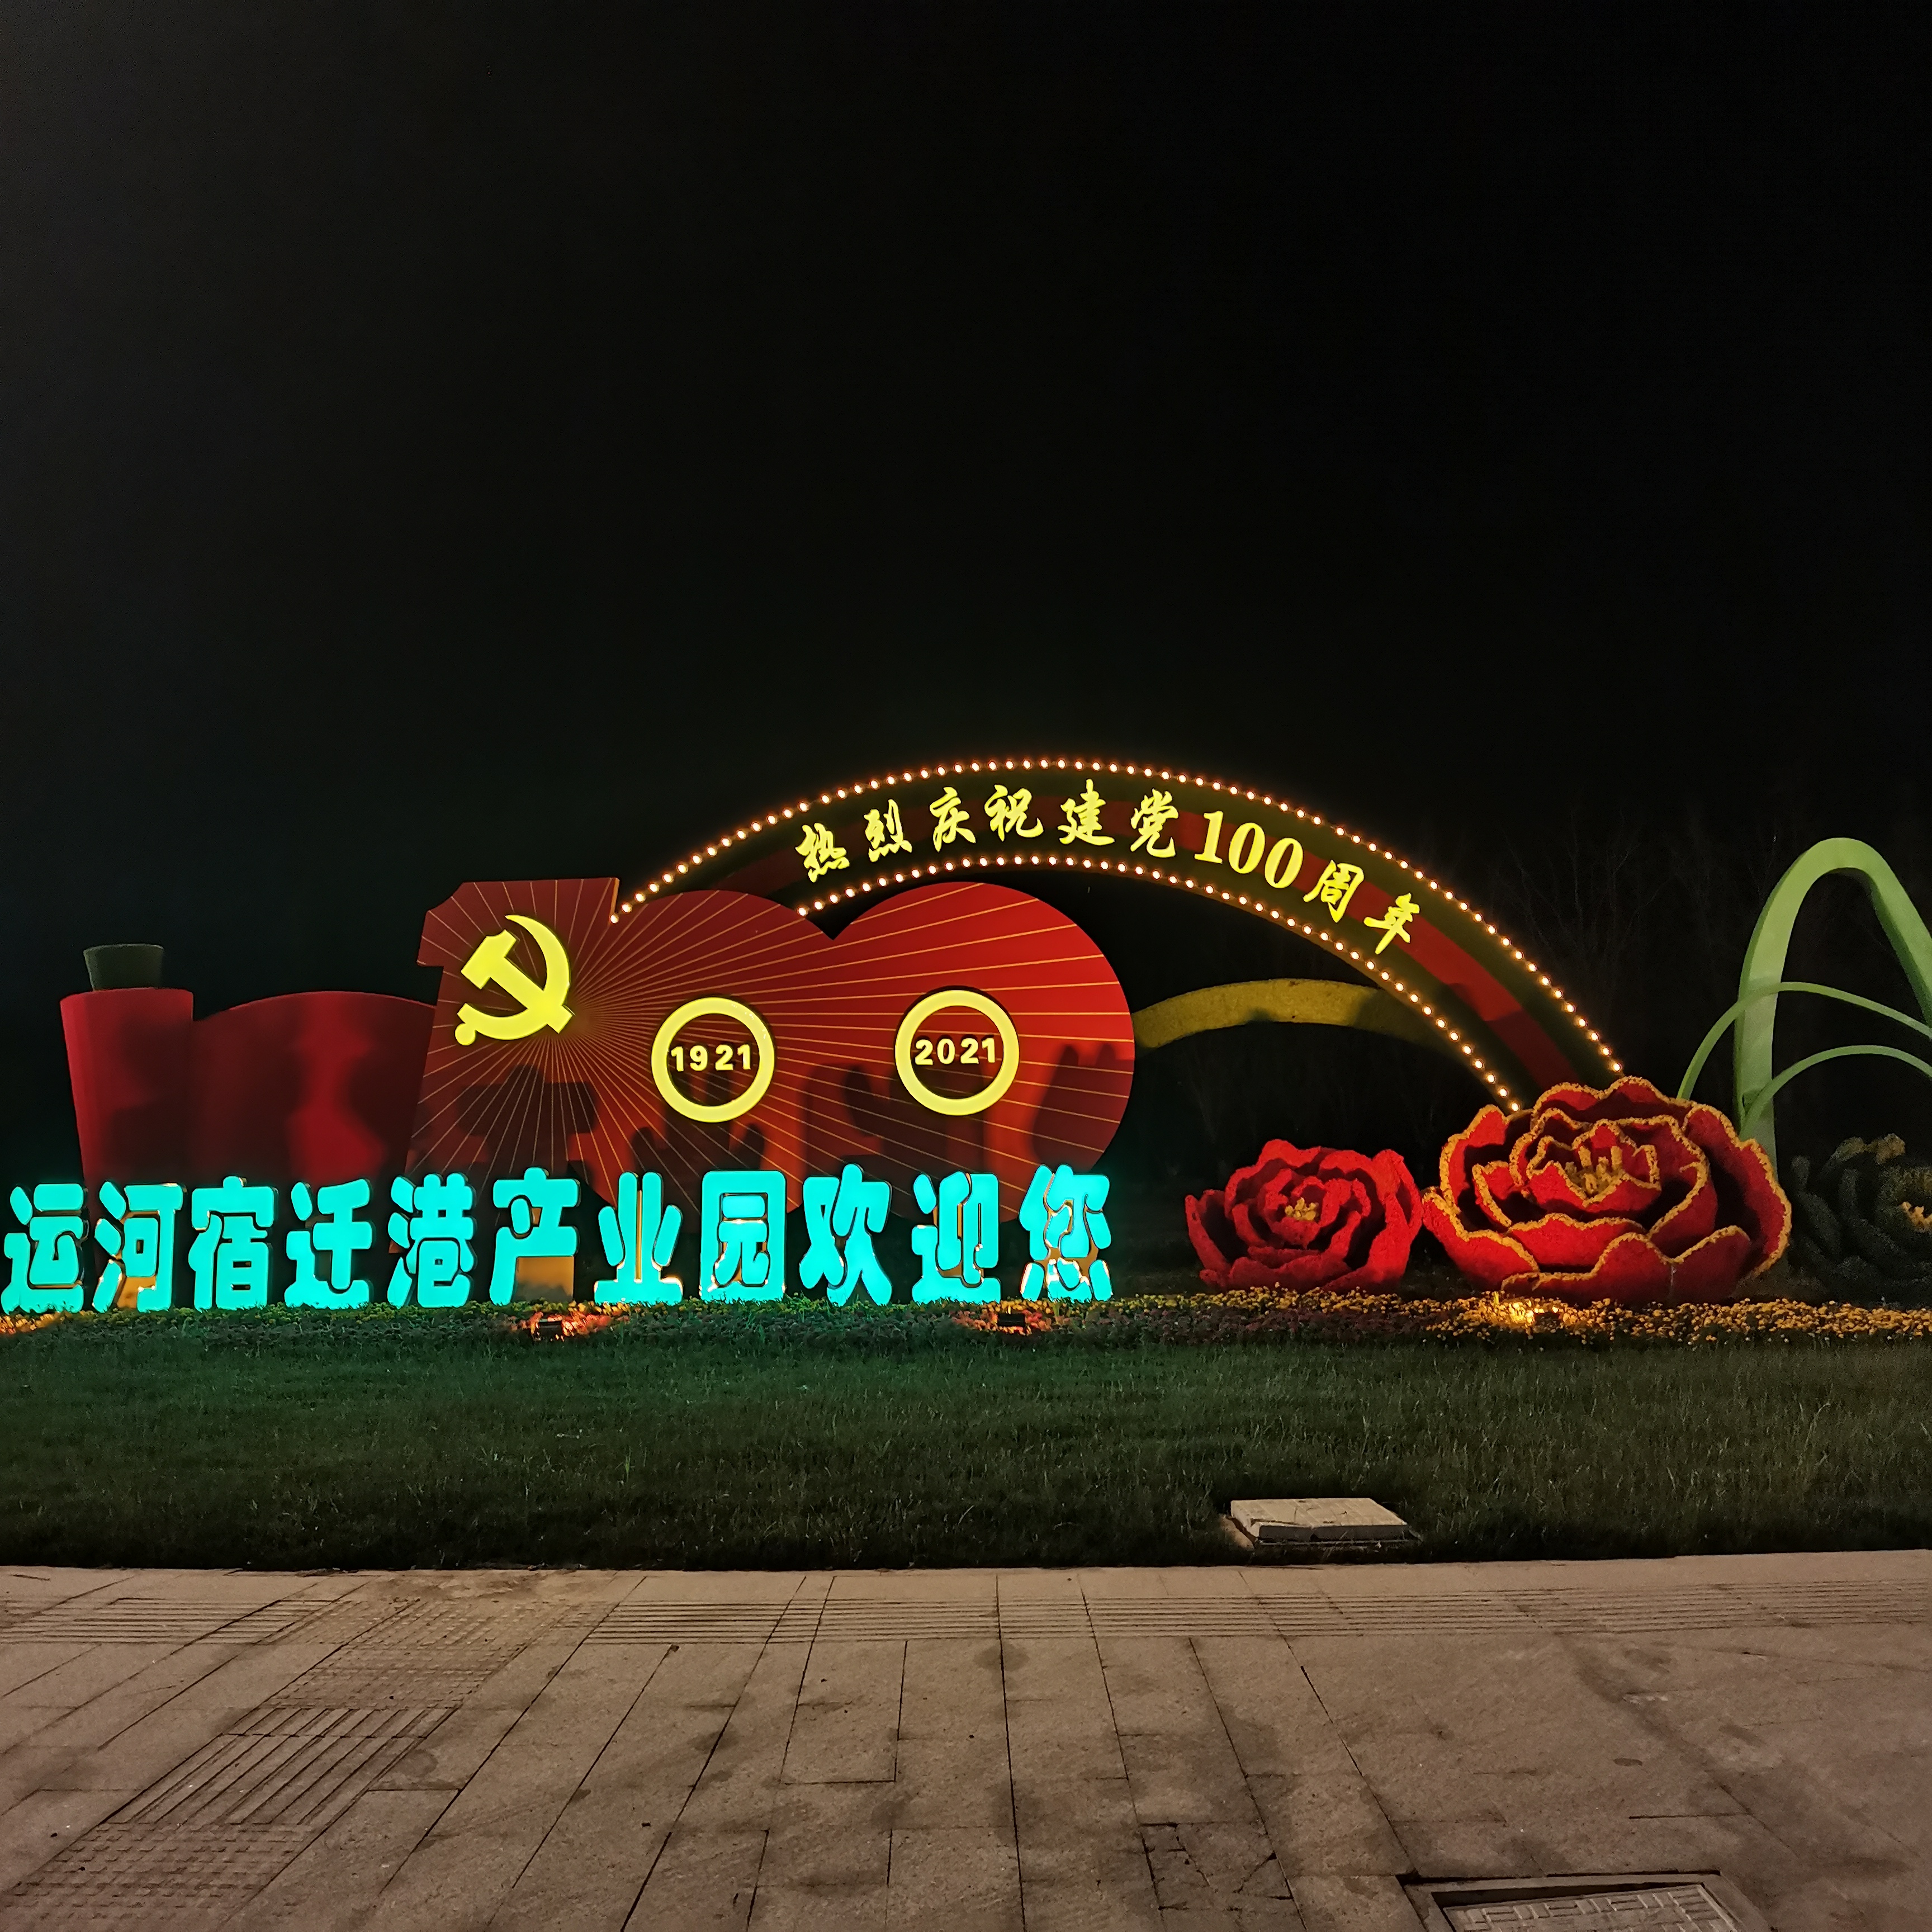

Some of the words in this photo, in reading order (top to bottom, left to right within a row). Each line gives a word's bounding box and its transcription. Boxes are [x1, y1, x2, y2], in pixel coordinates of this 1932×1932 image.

[796, 779, 1421, 954] 热烈庆祝建党100周年
[671, 1044, 751, 1072] 1921
[915, 1038, 996, 1066] 2021
[1, 1163, 1113, 1315] 运河宿迁港产业园欢迎您
